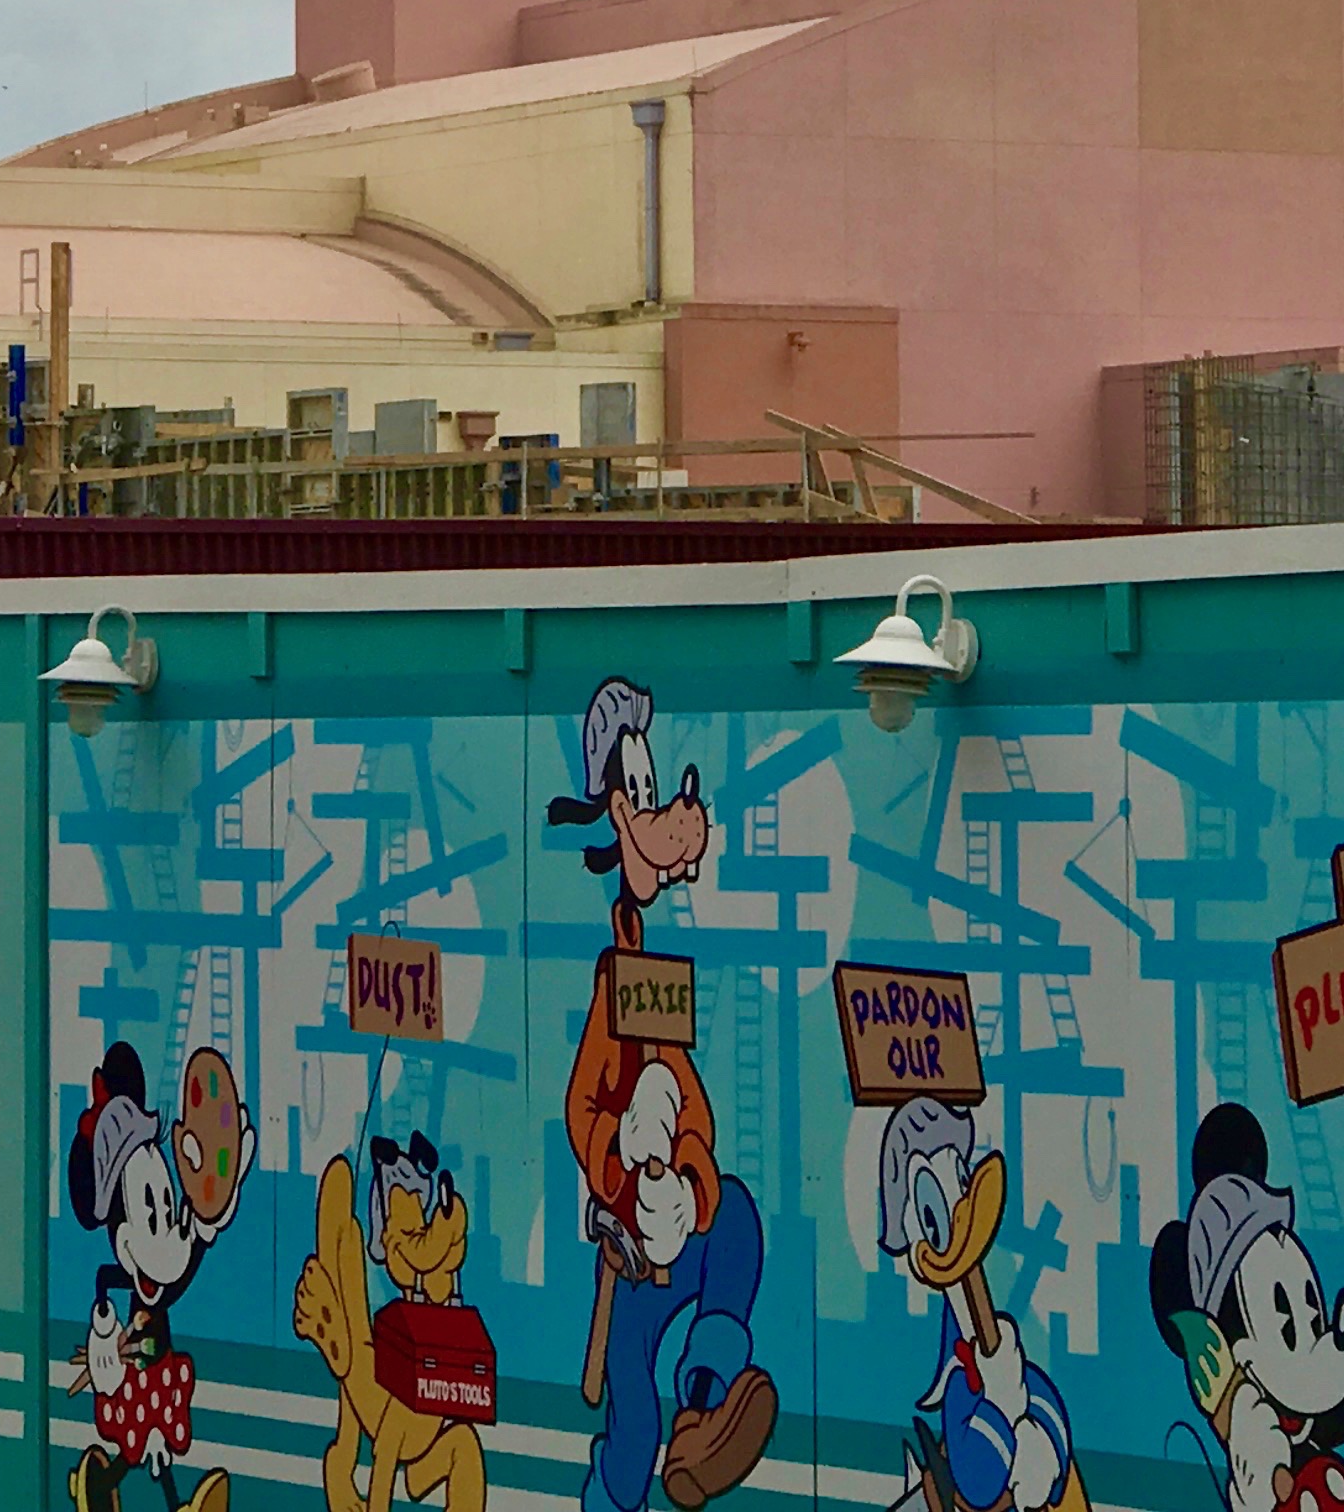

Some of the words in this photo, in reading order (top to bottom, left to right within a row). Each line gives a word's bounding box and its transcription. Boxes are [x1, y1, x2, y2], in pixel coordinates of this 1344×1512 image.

[358, 951, 437, 1029] DUST!
[618, 978, 690, 1022] PIXIE
[850, 981, 966, 1037] PARDON
[887, 1034, 945, 1080] OUR
[458, 1381, 491, 1407] TOOLS
